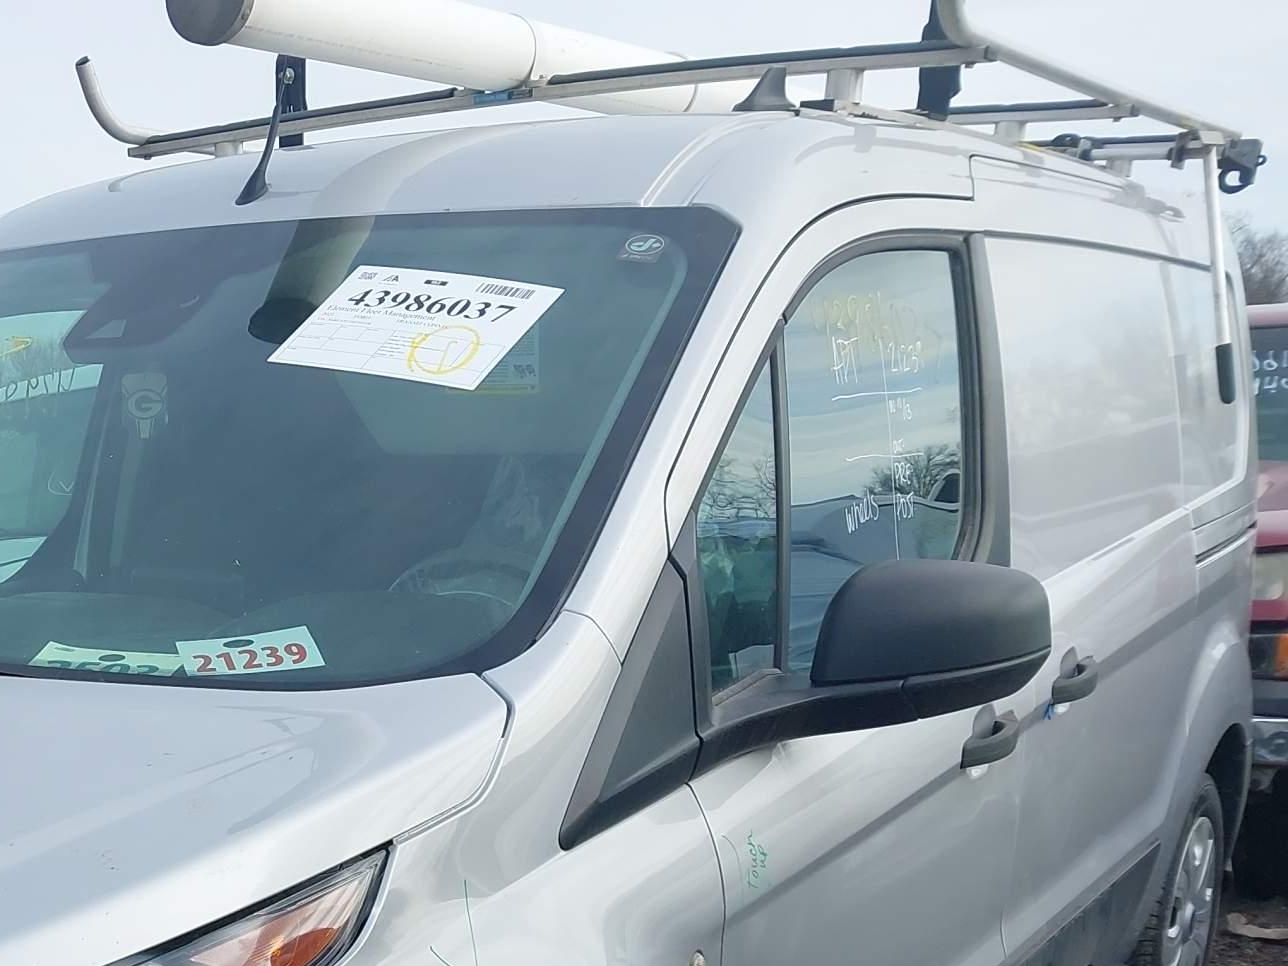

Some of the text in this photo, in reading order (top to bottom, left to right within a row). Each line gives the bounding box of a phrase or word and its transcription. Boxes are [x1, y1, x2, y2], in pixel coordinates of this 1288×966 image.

[347, 286, 519, 324] 43986037
[383, 309, 437, 321] Management
[191, 642, 308, 674] 21239
